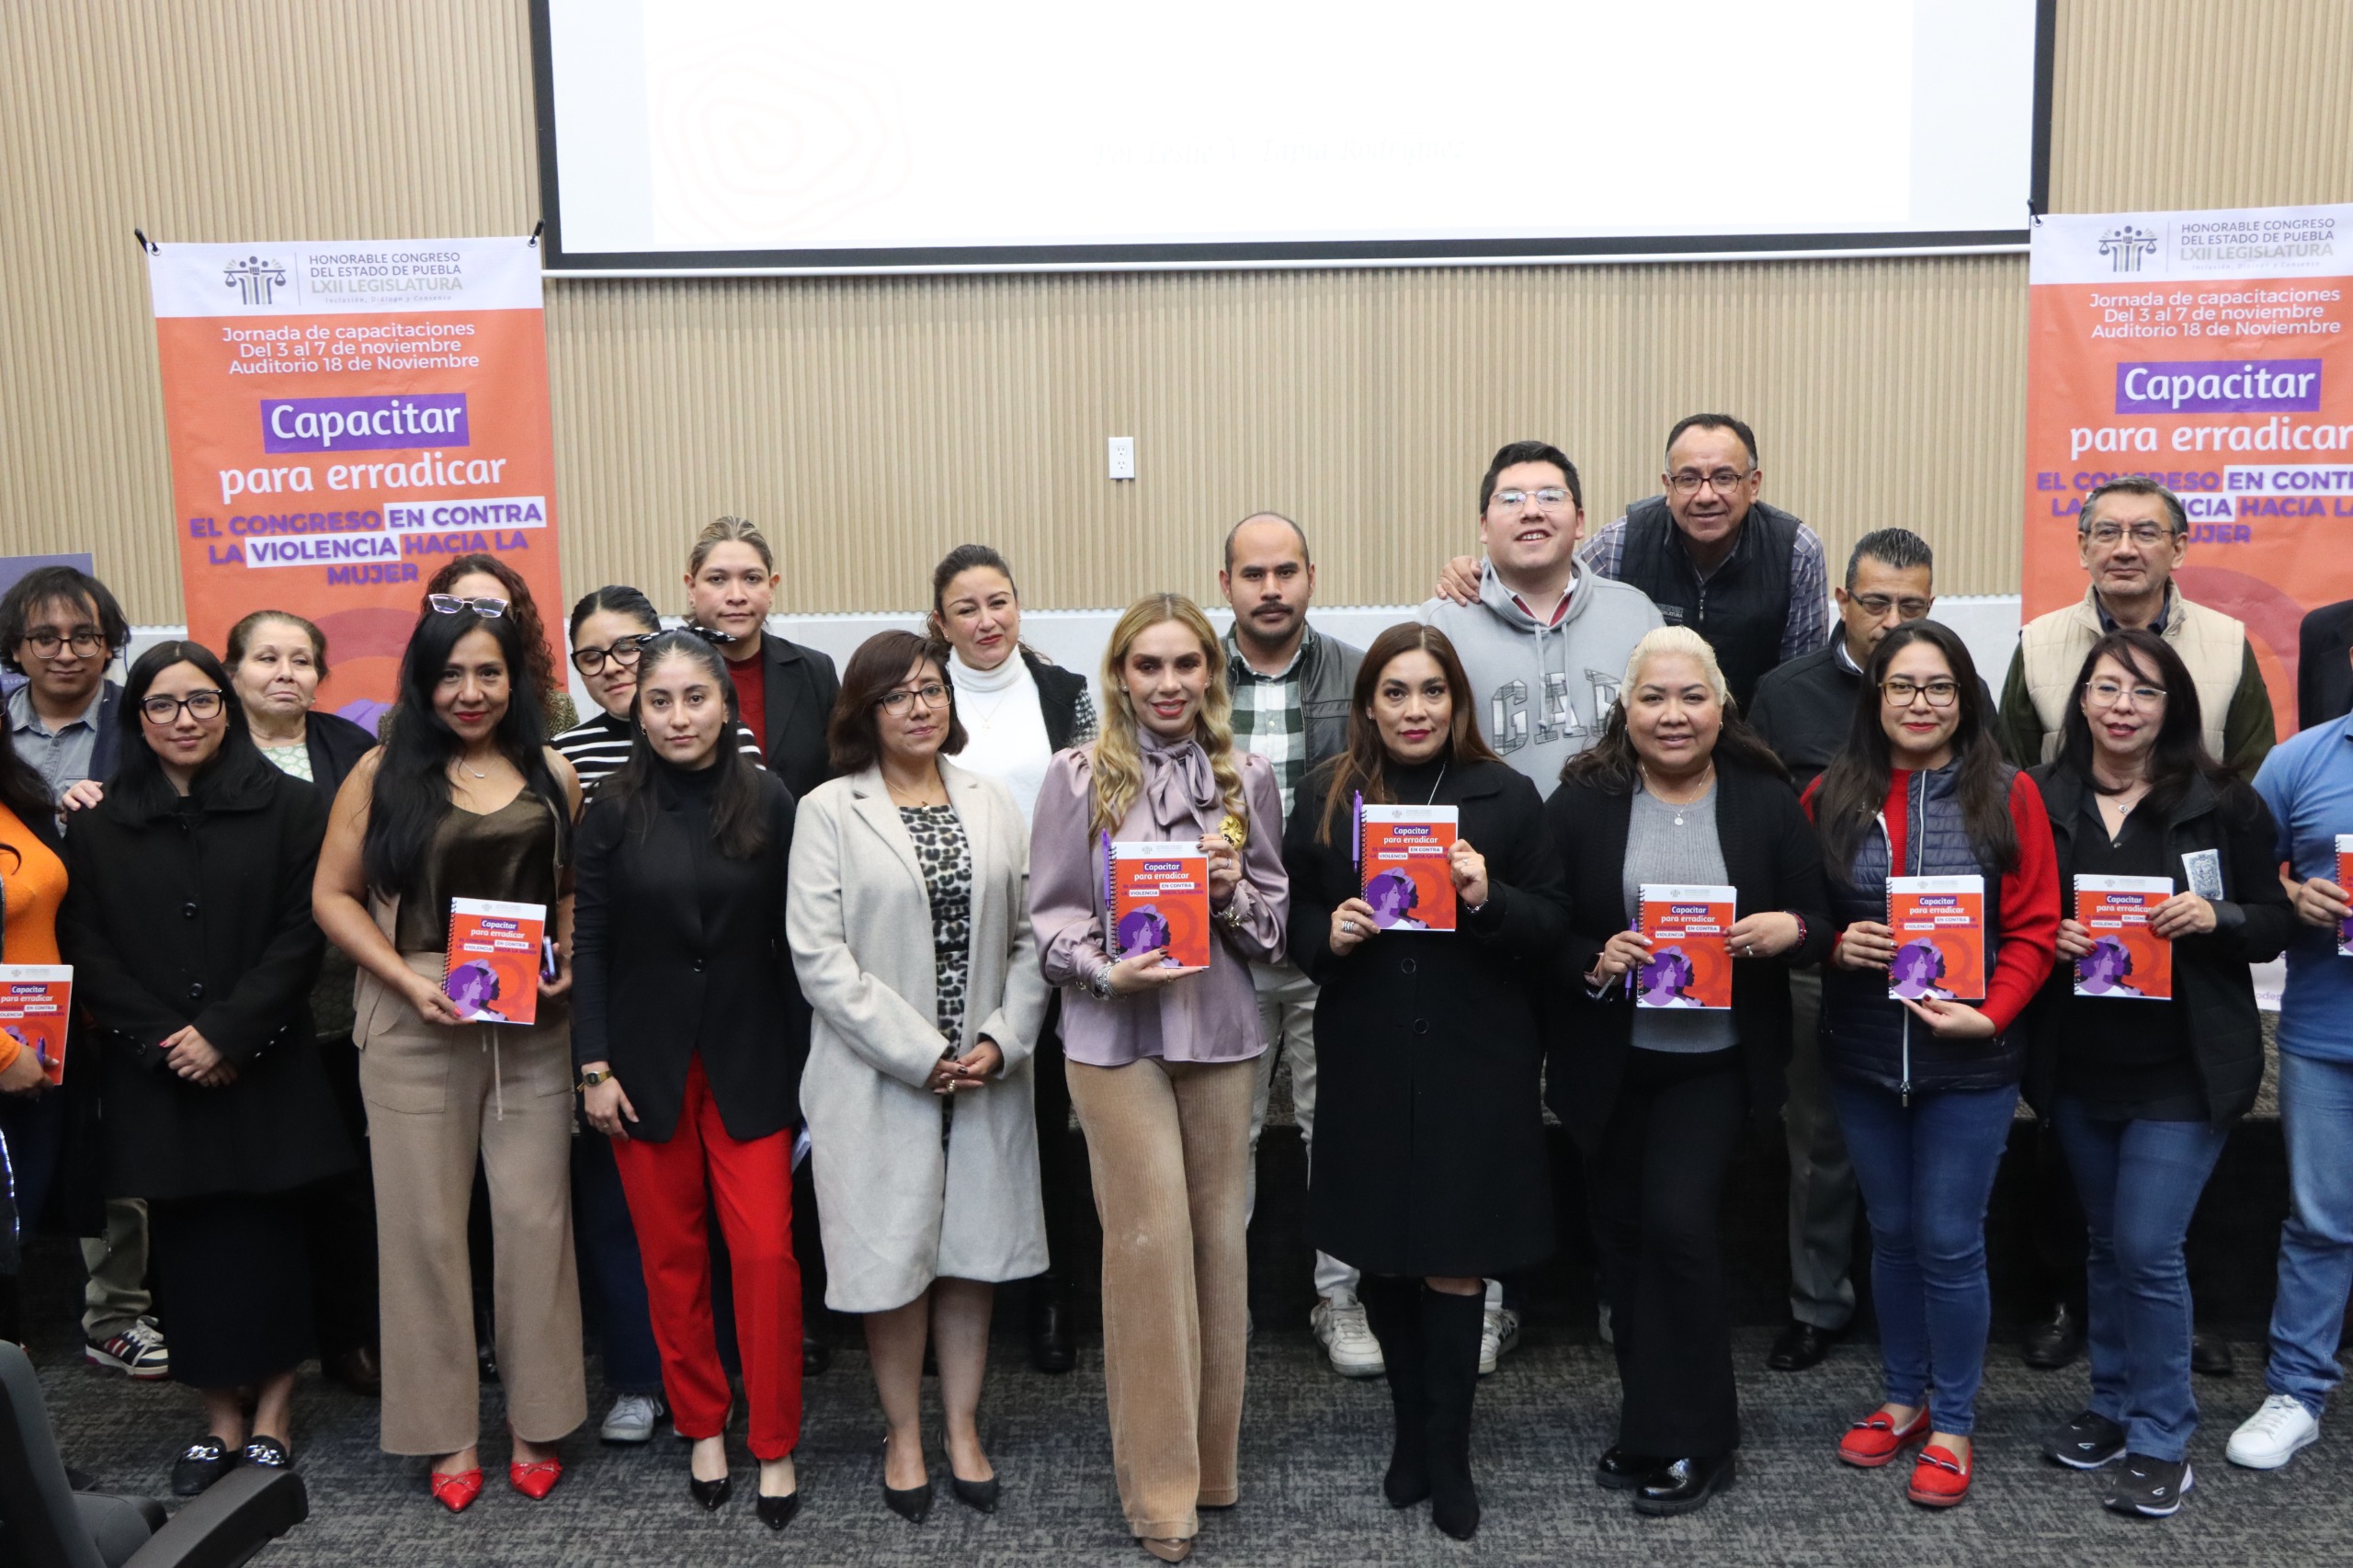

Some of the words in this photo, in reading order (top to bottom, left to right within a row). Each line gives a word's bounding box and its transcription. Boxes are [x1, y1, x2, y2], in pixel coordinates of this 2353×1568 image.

[2182, 222, 2260, 233] HONORABLE
[2264, 219, 2335, 230] CONGRESO
[2181, 235, 2204, 245] DEL
[2209, 234, 2258, 244] ESTADO
[2263, 233, 2279, 243] DE
[2284, 231, 2334, 242] PUEBLA
[309, 254, 388, 265] HONORABLE
[392, 252, 460, 263] CONGRESO
[2180, 247, 2211, 261] LXII
[2217, 243, 2334, 260] LEGISLATURA
[311, 267, 335, 278] DEL
[338, 267, 388, 277] ESTADO
[392, 266, 409, 276] DE
[413, 265, 461, 275] PUEBLA
[311, 279, 342, 294] LXII
[348, 278, 463, 292] LEGISLATURA
[2090, 291, 2164, 307] Jornada
[2169, 291, 2192, 305] de
[2198, 288, 2341, 307] capacitaciones
[2105, 308, 2133, 322] Del
[2139, 308, 2150, 322] 3
[2154, 307, 2170, 321] al
[2176, 307, 2188, 321] 7
[2192, 306, 2215, 321] de
[2222, 304, 2325, 320] noviembre
[222, 325, 301, 341] Jornada
[306, 324, 330, 340] de
[335, 322, 475, 341] capacitaciones
[2091, 324, 2177, 338] Auditorio
[2182, 323, 2200, 336] 18
[2206, 322, 2230, 335] de
[2235, 319, 2341, 335] Noviembre
[240, 343, 271, 358] Del
[277, 343, 289, 357] 3
[293, 341, 310, 357] al
[313, 342, 326, 356] 7
[331, 340, 356, 355] de
[361, 338, 461, 354] noviembre
[229, 358, 318, 374] Auditorio
[323, 358, 343, 372] 18
[347, 356, 371, 371] de
[377, 354, 480, 369] Noviembre
[2124, 364, 2316, 409] Capacitar
[271, 399, 461, 448] Capacitar
[2070, 426, 2158, 460] para
[2171, 416, 2353, 451] erradicar
[219, 466, 314, 505] para
[327, 451, 506, 490] erradicar
[2037, 472, 2066, 491] EL
[2074, 472, 2220, 491] CORESO
[2228, 472, 2264, 490] EN
[2272, 471, 2353, 490] CONT
[2052, 497, 2082, 517] LA
[2241, 497, 2325, 517] HACIA
[190, 517, 222, 538] EL
[229, 510, 381, 535] CONGRESO
[389, 508, 425, 528] EN
[432, 504, 542, 526] CONTRA
[2188, 525, 2251, 544] UJER
[209, 544, 244, 564] LA
[250, 537, 397, 562] VIOLENCIA
[404, 532, 488, 555] HACIA
[494, 530, 529, 551] LA
[327, 562, 419, 585] MUJER
[1491, 669, 1622, 756] GAP
[1393, 827, 1429, 835] Capacitar
[1404, 835, 1438, 844] erradicar
[1144, 862, 1179, 872] Capacitar
[1919, 897, 1955, 906] Capacitar
[2107, 895, 2143, 903] Capacitar
[1671, 906, 1707, 915] Capacitar
[1681, 915, 1716, 923] erradicar
[482, 920, 517, 929] Capacitar
[490, 930, 525, 938] erradicar
[12, 985, 46, 994] Capacitar
[1, 995, 18, 1004] para
